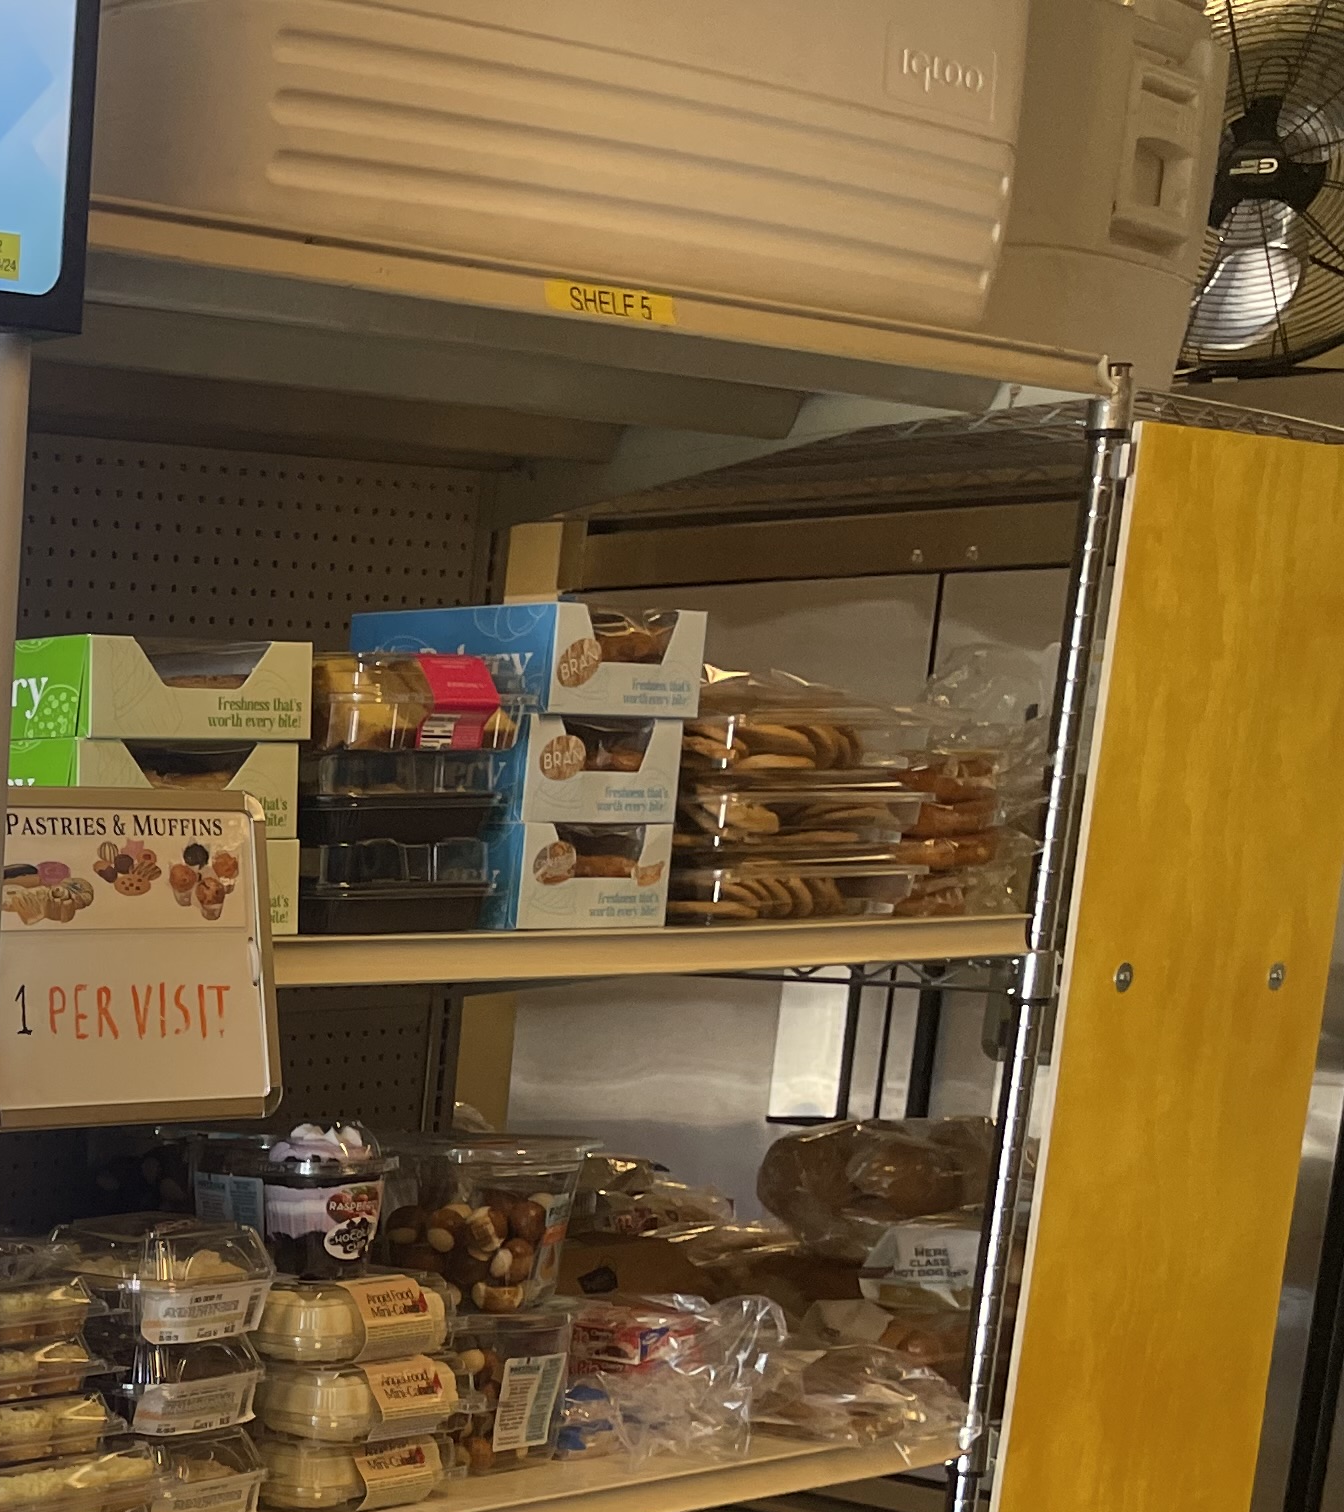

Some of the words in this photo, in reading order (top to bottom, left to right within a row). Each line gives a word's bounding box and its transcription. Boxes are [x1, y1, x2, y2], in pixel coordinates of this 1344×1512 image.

[570, 286, 630, 316] SHELF
[641, 296, 652, 320] 5
[560, 650, 600, 681] BRAN
[218, 696, 271, 712] Freshness
[273, 697, 303, 713] that's
[208, 714, 243, 729] worth
[245, 716, 276, 731] every
[278, 713, 302, 729] bite!
[543, 750, 587, 770] BRAN
[6, 813, 108, 837] PASTRIES
[133, 814, 223, 838] MUFFINS
[14, 984, 34, 1036] 1
[47, 984, 119, 1040] PER
[130, 981, 231, 1040] VISIT
